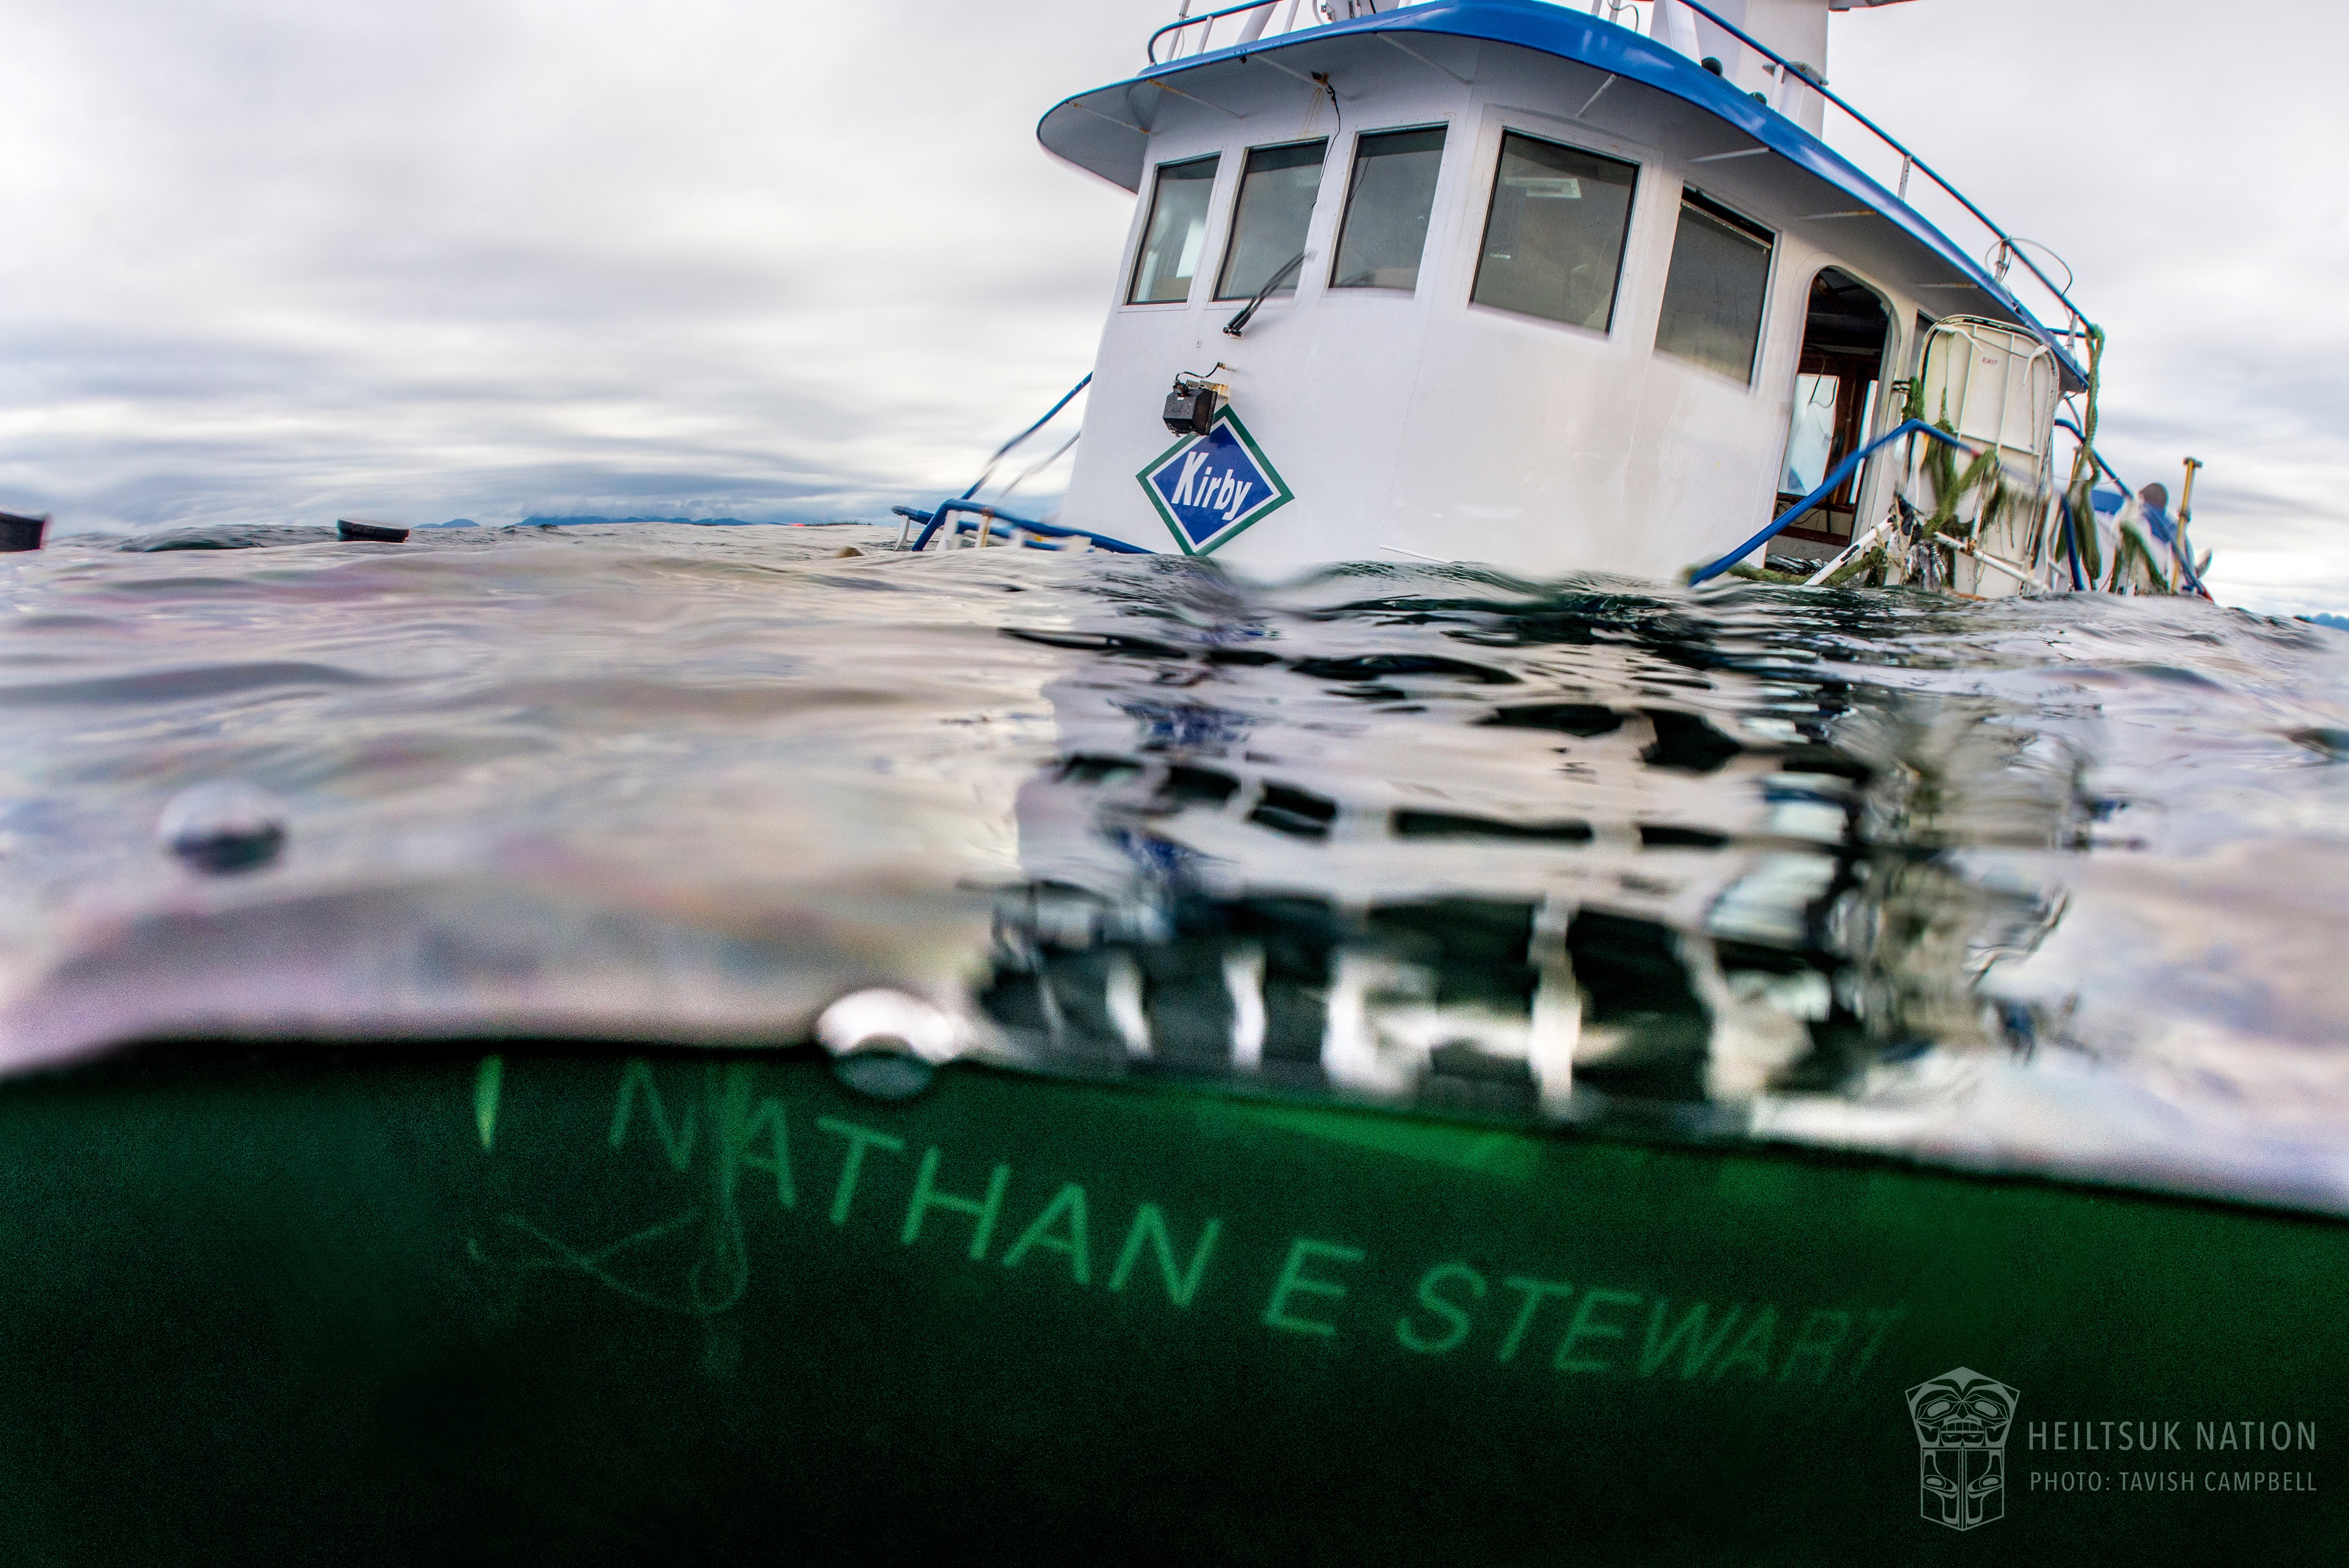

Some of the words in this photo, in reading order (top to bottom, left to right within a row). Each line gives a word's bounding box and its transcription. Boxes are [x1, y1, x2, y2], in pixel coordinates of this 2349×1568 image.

[1982, 357, 1998, 365] EXIT
[1171, 450, 1253, 521] Kirby
[608, 1057, 1225, 1307] NATHAN
[1261, 1237, 1366, 1337] E
[1395, 1262, 1911, 1386] STEWART
